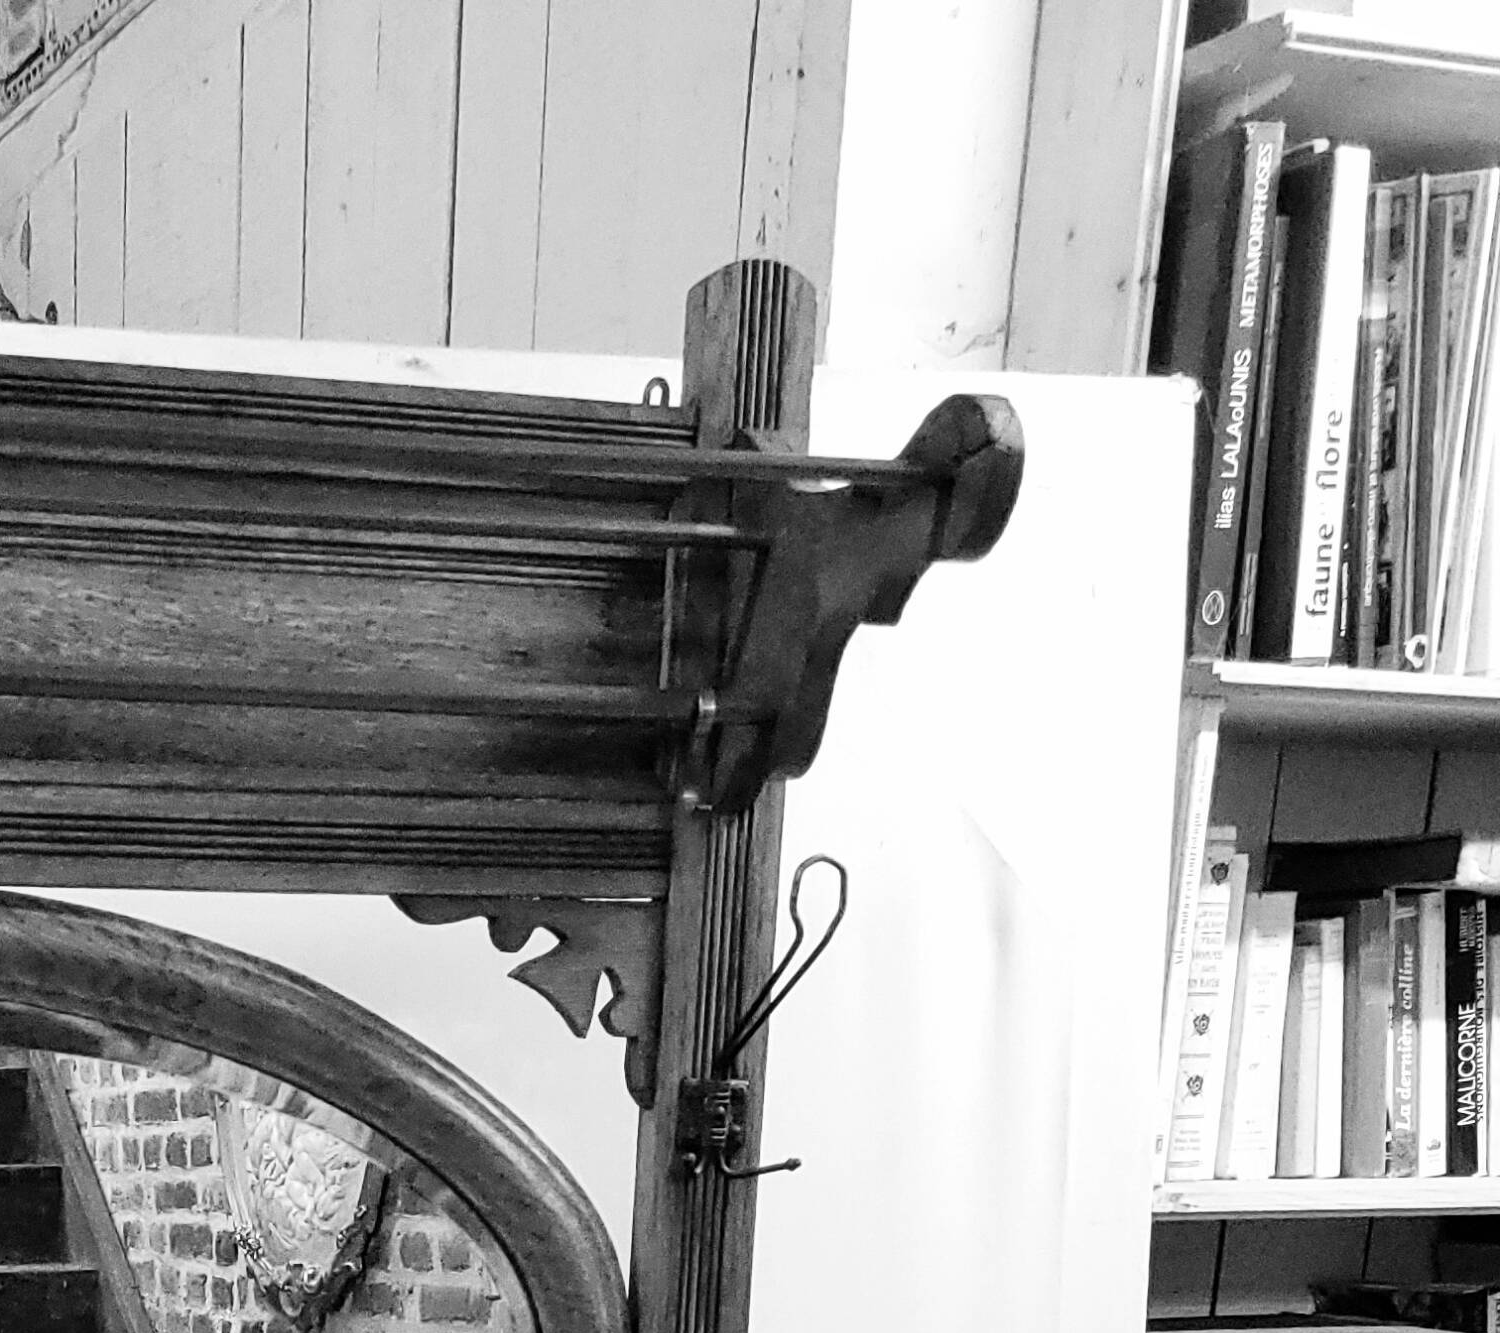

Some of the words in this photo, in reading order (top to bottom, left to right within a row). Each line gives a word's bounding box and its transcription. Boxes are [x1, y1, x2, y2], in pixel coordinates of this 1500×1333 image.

[1214, 486, 1236, 529] ilias
[1239, 143, 1274, 328] METAMORPHOSES
[1315, 408, 1344, 491] flore
[1306, 523, 1335, 617] faune
[1395, 943, 1415, 1010] colline
[1475, 911, 1484, 969] HISTOIRE
[1475, 977, 1484, 1000] DES
[1393, 1014, 1413, 1099] dernière
[1457, 1002, 1478, 1127] MALICORNE
[1395, 1103, 1413, 1131] La
